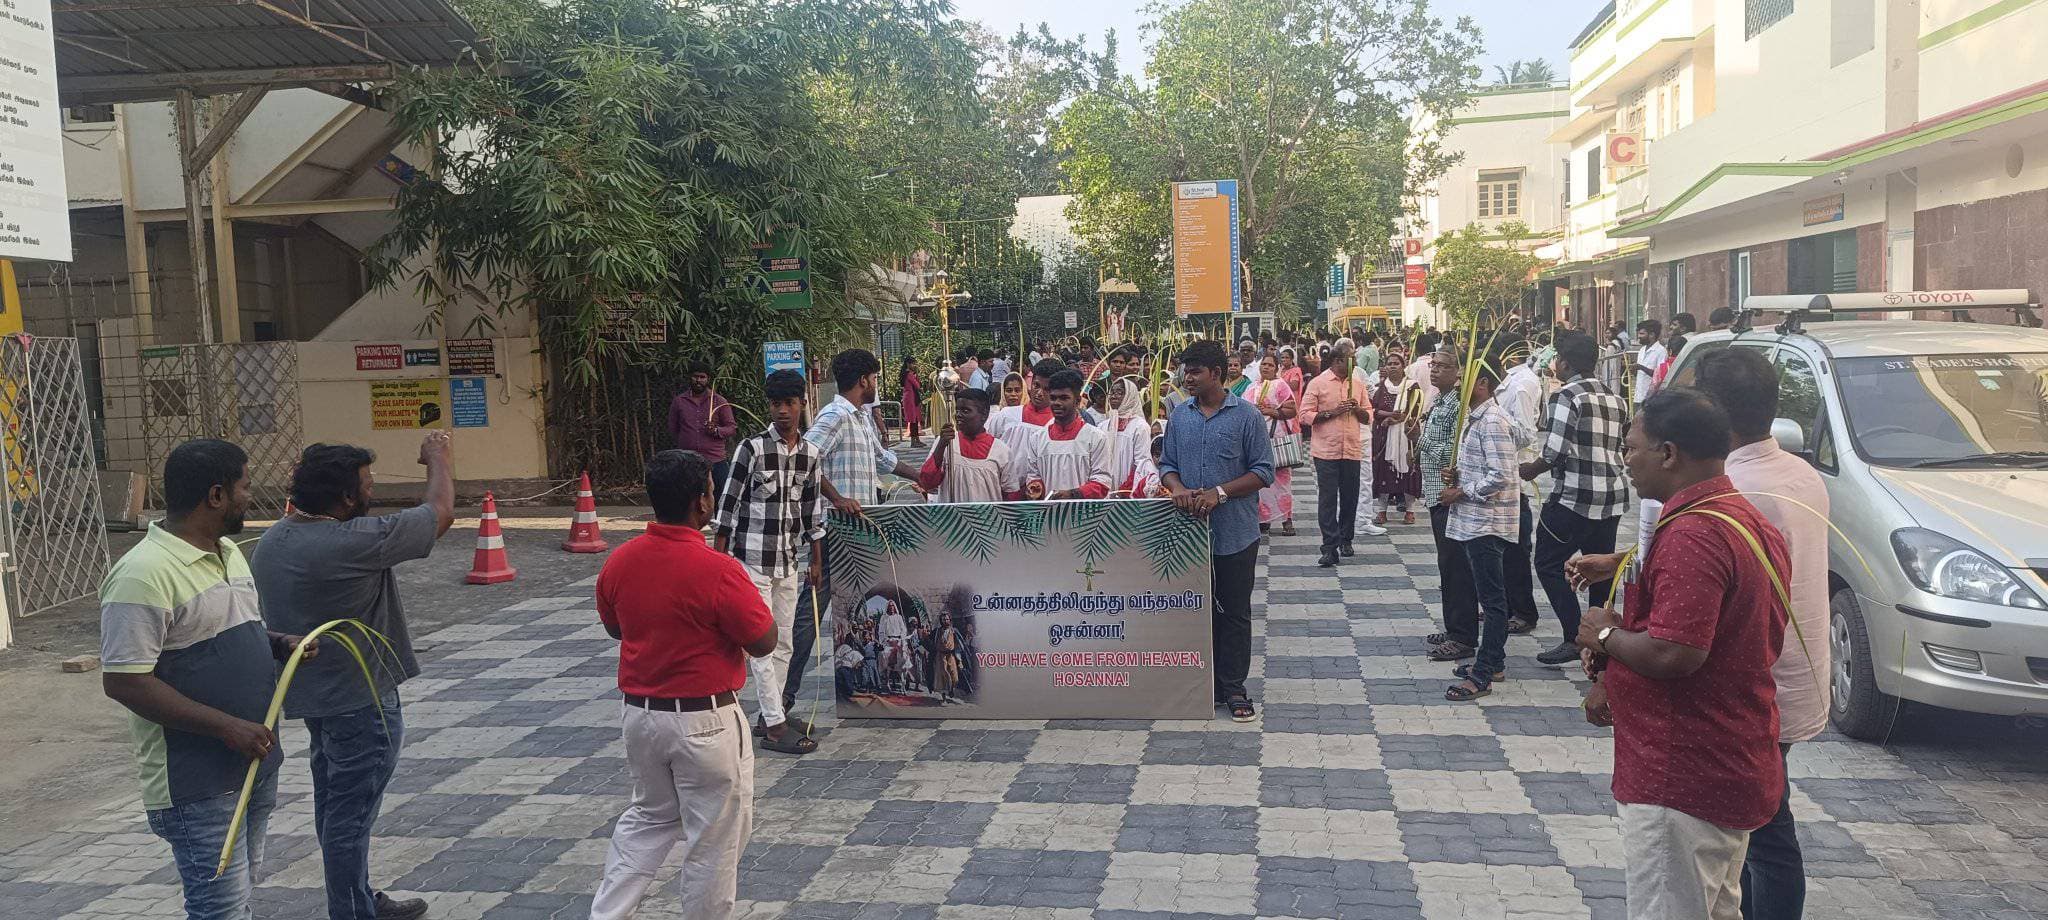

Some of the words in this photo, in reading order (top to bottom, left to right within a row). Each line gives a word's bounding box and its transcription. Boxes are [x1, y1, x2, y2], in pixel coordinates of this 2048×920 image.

[1610, 136, 1636, 163] C
[1405, 240, 1421, 255] D
[1908, 292, 1974, 304] TOYOTA
[356, 346, 381, 357] PARKING
[382, 345, 401, 356] TOKEN
[763, 343, 776, 352] TWO
[777, 342, 802, 351] WHEELER
[767, 352, 790, 361] PARKING
[361, 358, 398, 369] RETURNABLE
[1884, 360, 1910, 371] ST.
[392, 399, 404, 407] SAFE
[972, 591, 1125, 616] உன்னதத்திலிருந்து
[1128, 590, 1204, 615] வந்தவரே
[1049, 620, 1126, 646] ஓசன்னா!
[977, 652, 1007, 667] YOU
[1010, 652, 1047, 667] HAVE
[1051, 652, 1093, 667] COME
[1096, 652, 1138, 667] FROM
[1141, 650, 1205, 669] HEAVEN,
[1054, 671, 1130, 687] HOSANNA!
